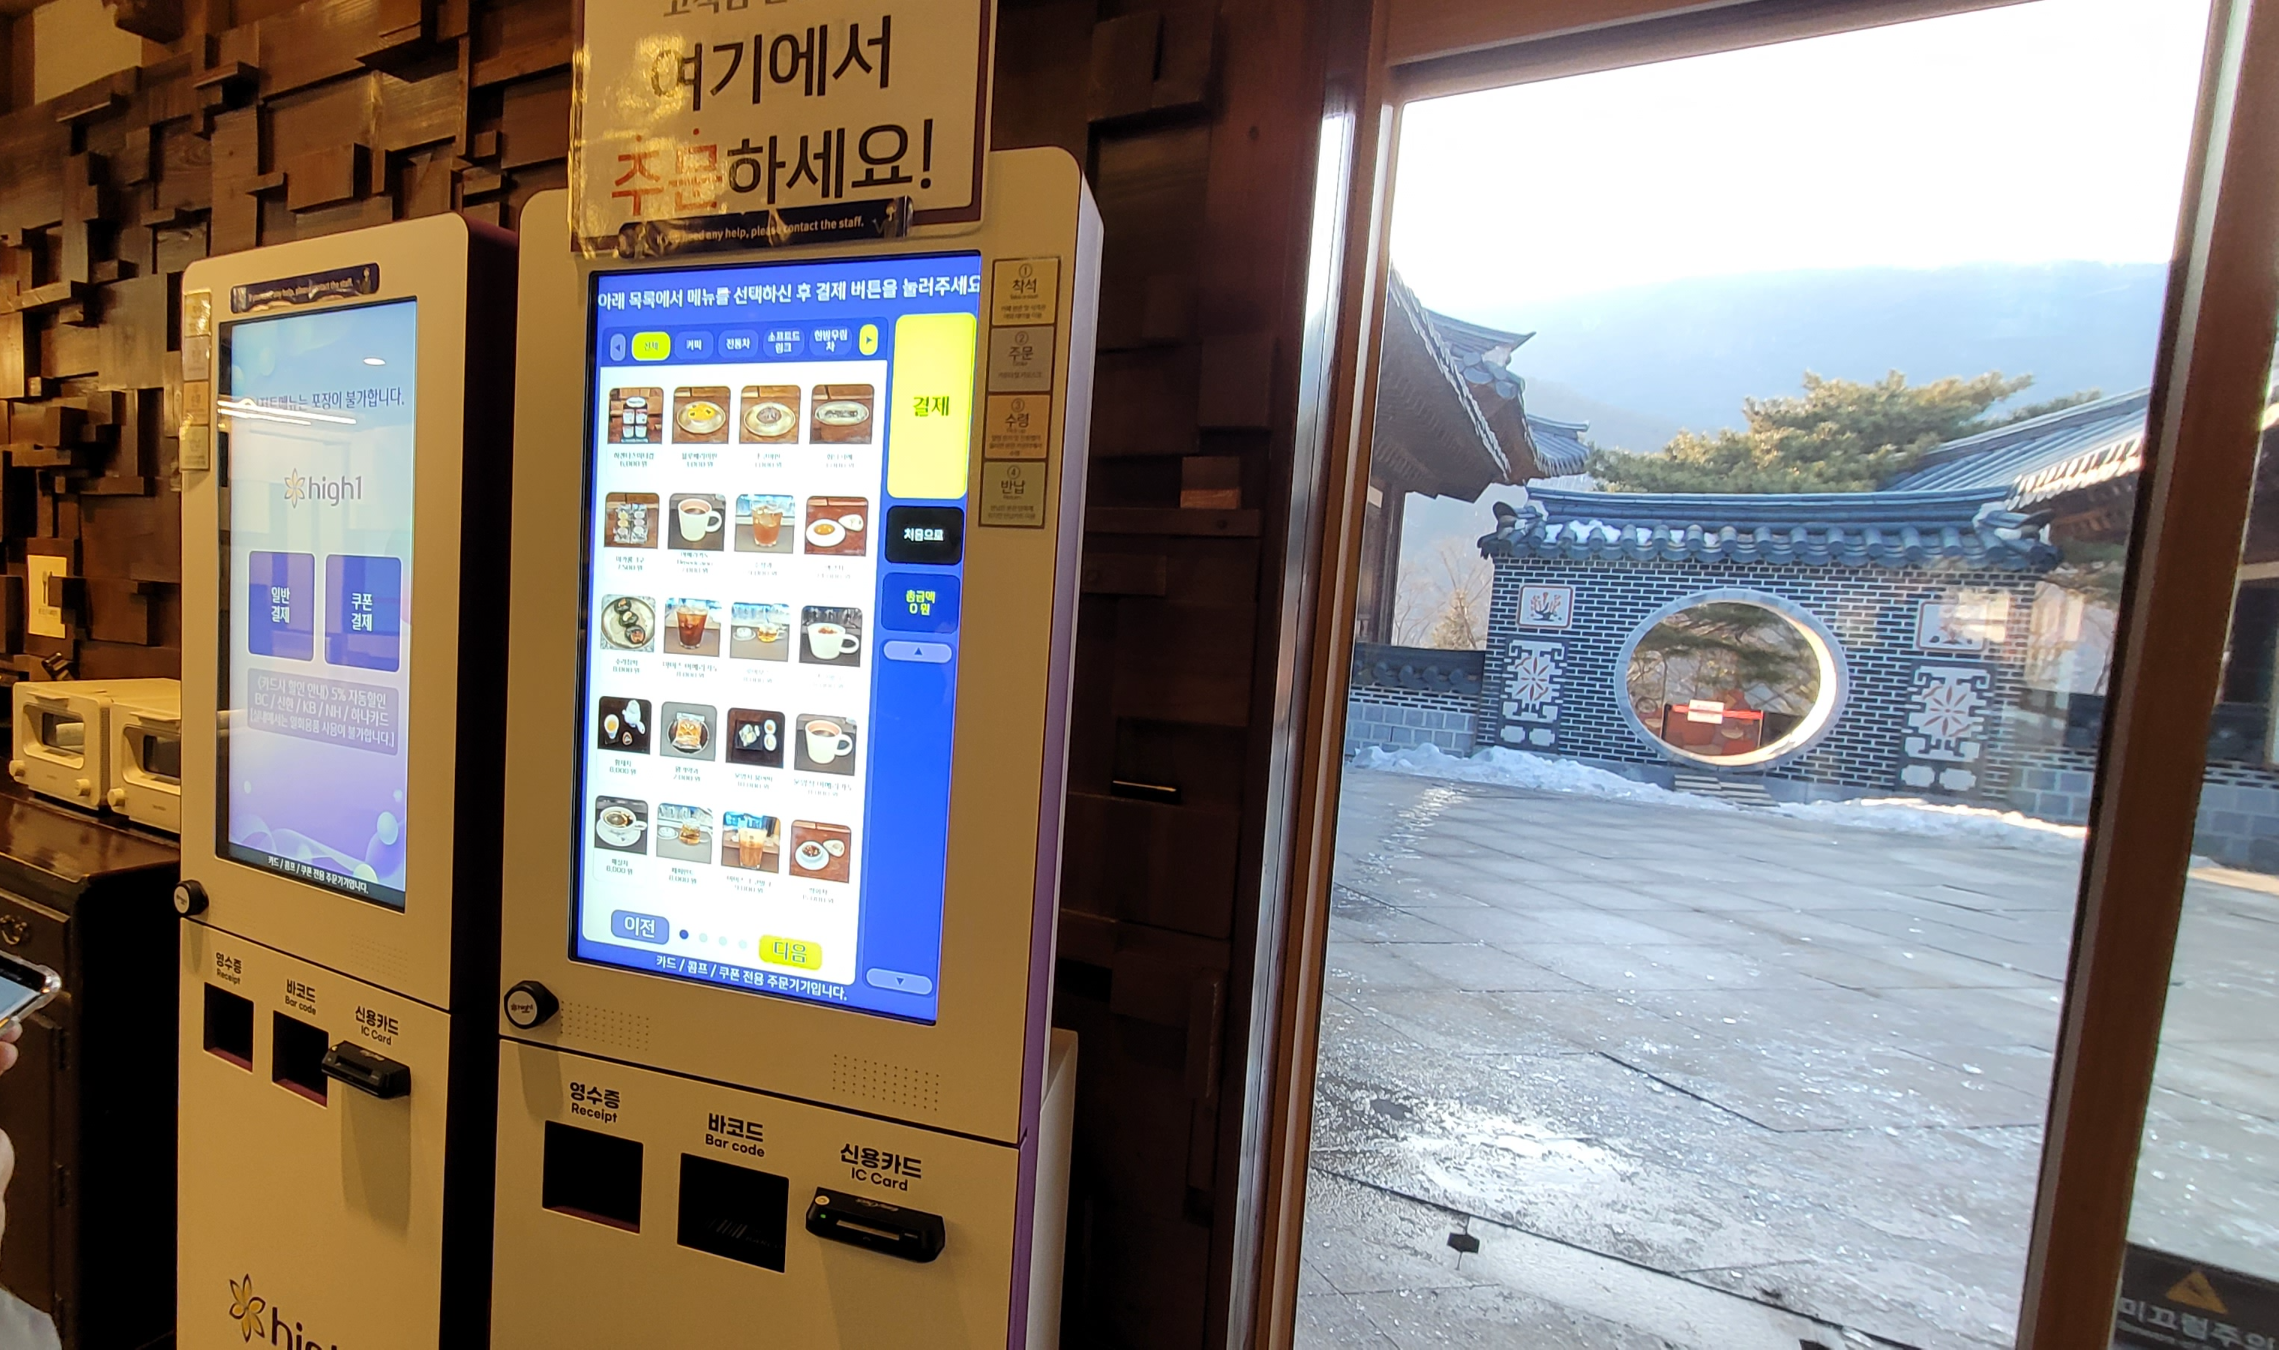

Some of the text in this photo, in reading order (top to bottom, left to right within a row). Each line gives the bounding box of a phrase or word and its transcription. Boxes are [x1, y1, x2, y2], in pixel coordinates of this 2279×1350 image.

[650, 14, 892, 112] 여기에서
[611, 118, 934, 216] 주문하세요!
[725, 227, 750, 243] help,
[820, 219, 837, 231] the
[839, 215, 865, 229] staff.
[598, 291, 625, 311] 아래
[629, 289, 684, 309] 목록에서
[687, 287, 731, 307] 메뉴를
[733, 284, 792, 305] 선택하신
[796, 282, 812, 302] 후
[816, 281, 846, 301] 결제
[851, 278, 898, 300] 버튼을
[1012, 278, 1037, 294] 착석
[1009, 346, 1033, 361] 주문
[312, 391, 343, 410] 포장이
[345, 387, 405, 410] 불가합니다.
[308, 475, 362, 507] high1
[1001, 480, 1025, 495] 반납
[903, 527, 944, 542] 처음으로
[271, 586, 290, 604] 일반
[351, 592, 373, 611] 쿠폰
[271, 605, 290, 623] 결제
[351, 613, 373, 632] 결제
[331, 686, 347, 702] 5%
[255, 692, 269, 707] BC
[303, 699, 317, 715] KB
[325, 703, 341, 719] NH
[351, 707, 389, 727] 하나카드
[321, 721, 346, 739] 사용이
[268, 855, 279, 867] 카드
[301, 865, 313, 877] 쿠폰
[313, 868, 325, 881] 전용
[624, 916, 656, 939] 이전
[216, 952, 242, 975] 영수증
[773, 941, 807, 964] 다음
[656, 955, 677, 970] 카드
[687, 960, 708, 976] 콤프
[719, 966, 740, 982] 쿠폰
[743, 970, 764, 986] 전용
[767, 974, 848, 1001] 주문기기입니다.
[286, 978, 316, 1004] 바코드
[285, 995, 317, 1016] Bar code
[354, 1005, 399, 1036] 신용카드
[360, 1025, 392, 1046] IC Card
[569, 1081, 621, 1110] 영수증
[571, 1102, 618, 1124] Receipt
[707, 1112, 764, 1143] 바코드
[705, 1133, 765, 1158] Bar code
[840, 1143, 922, 1180] 신용카드
[851, 1166, 909, 1192] IC Card
